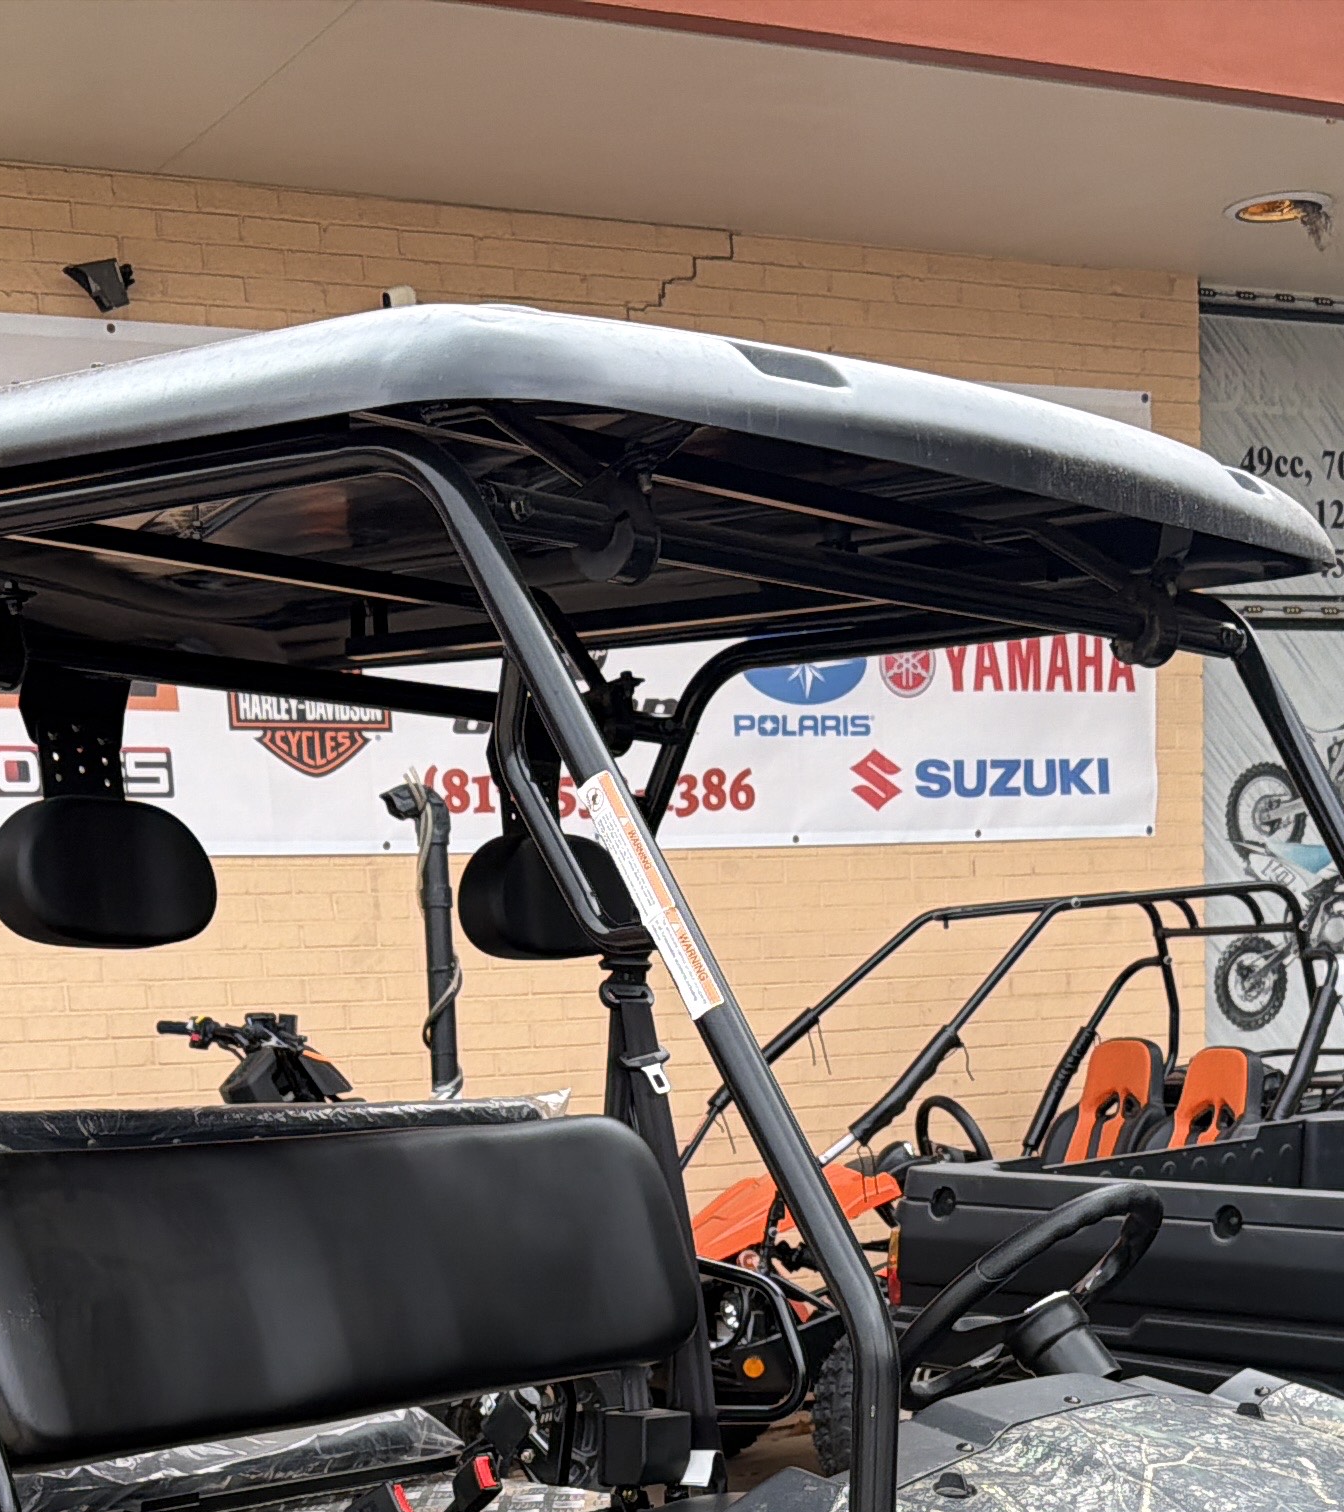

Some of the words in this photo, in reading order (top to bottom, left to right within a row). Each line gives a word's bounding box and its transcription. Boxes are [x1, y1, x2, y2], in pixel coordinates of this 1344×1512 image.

[1240, 446, 1313, 487] 49cc,
[945, 633, 1137, 693] YAMAHA
[733, 714, 873, 737] POLARIS
[274, 730, 352, 767] CYCLES
[914, 757, 1110, 799] SUZUKI
[678, 932, 709, 984] WARNING
